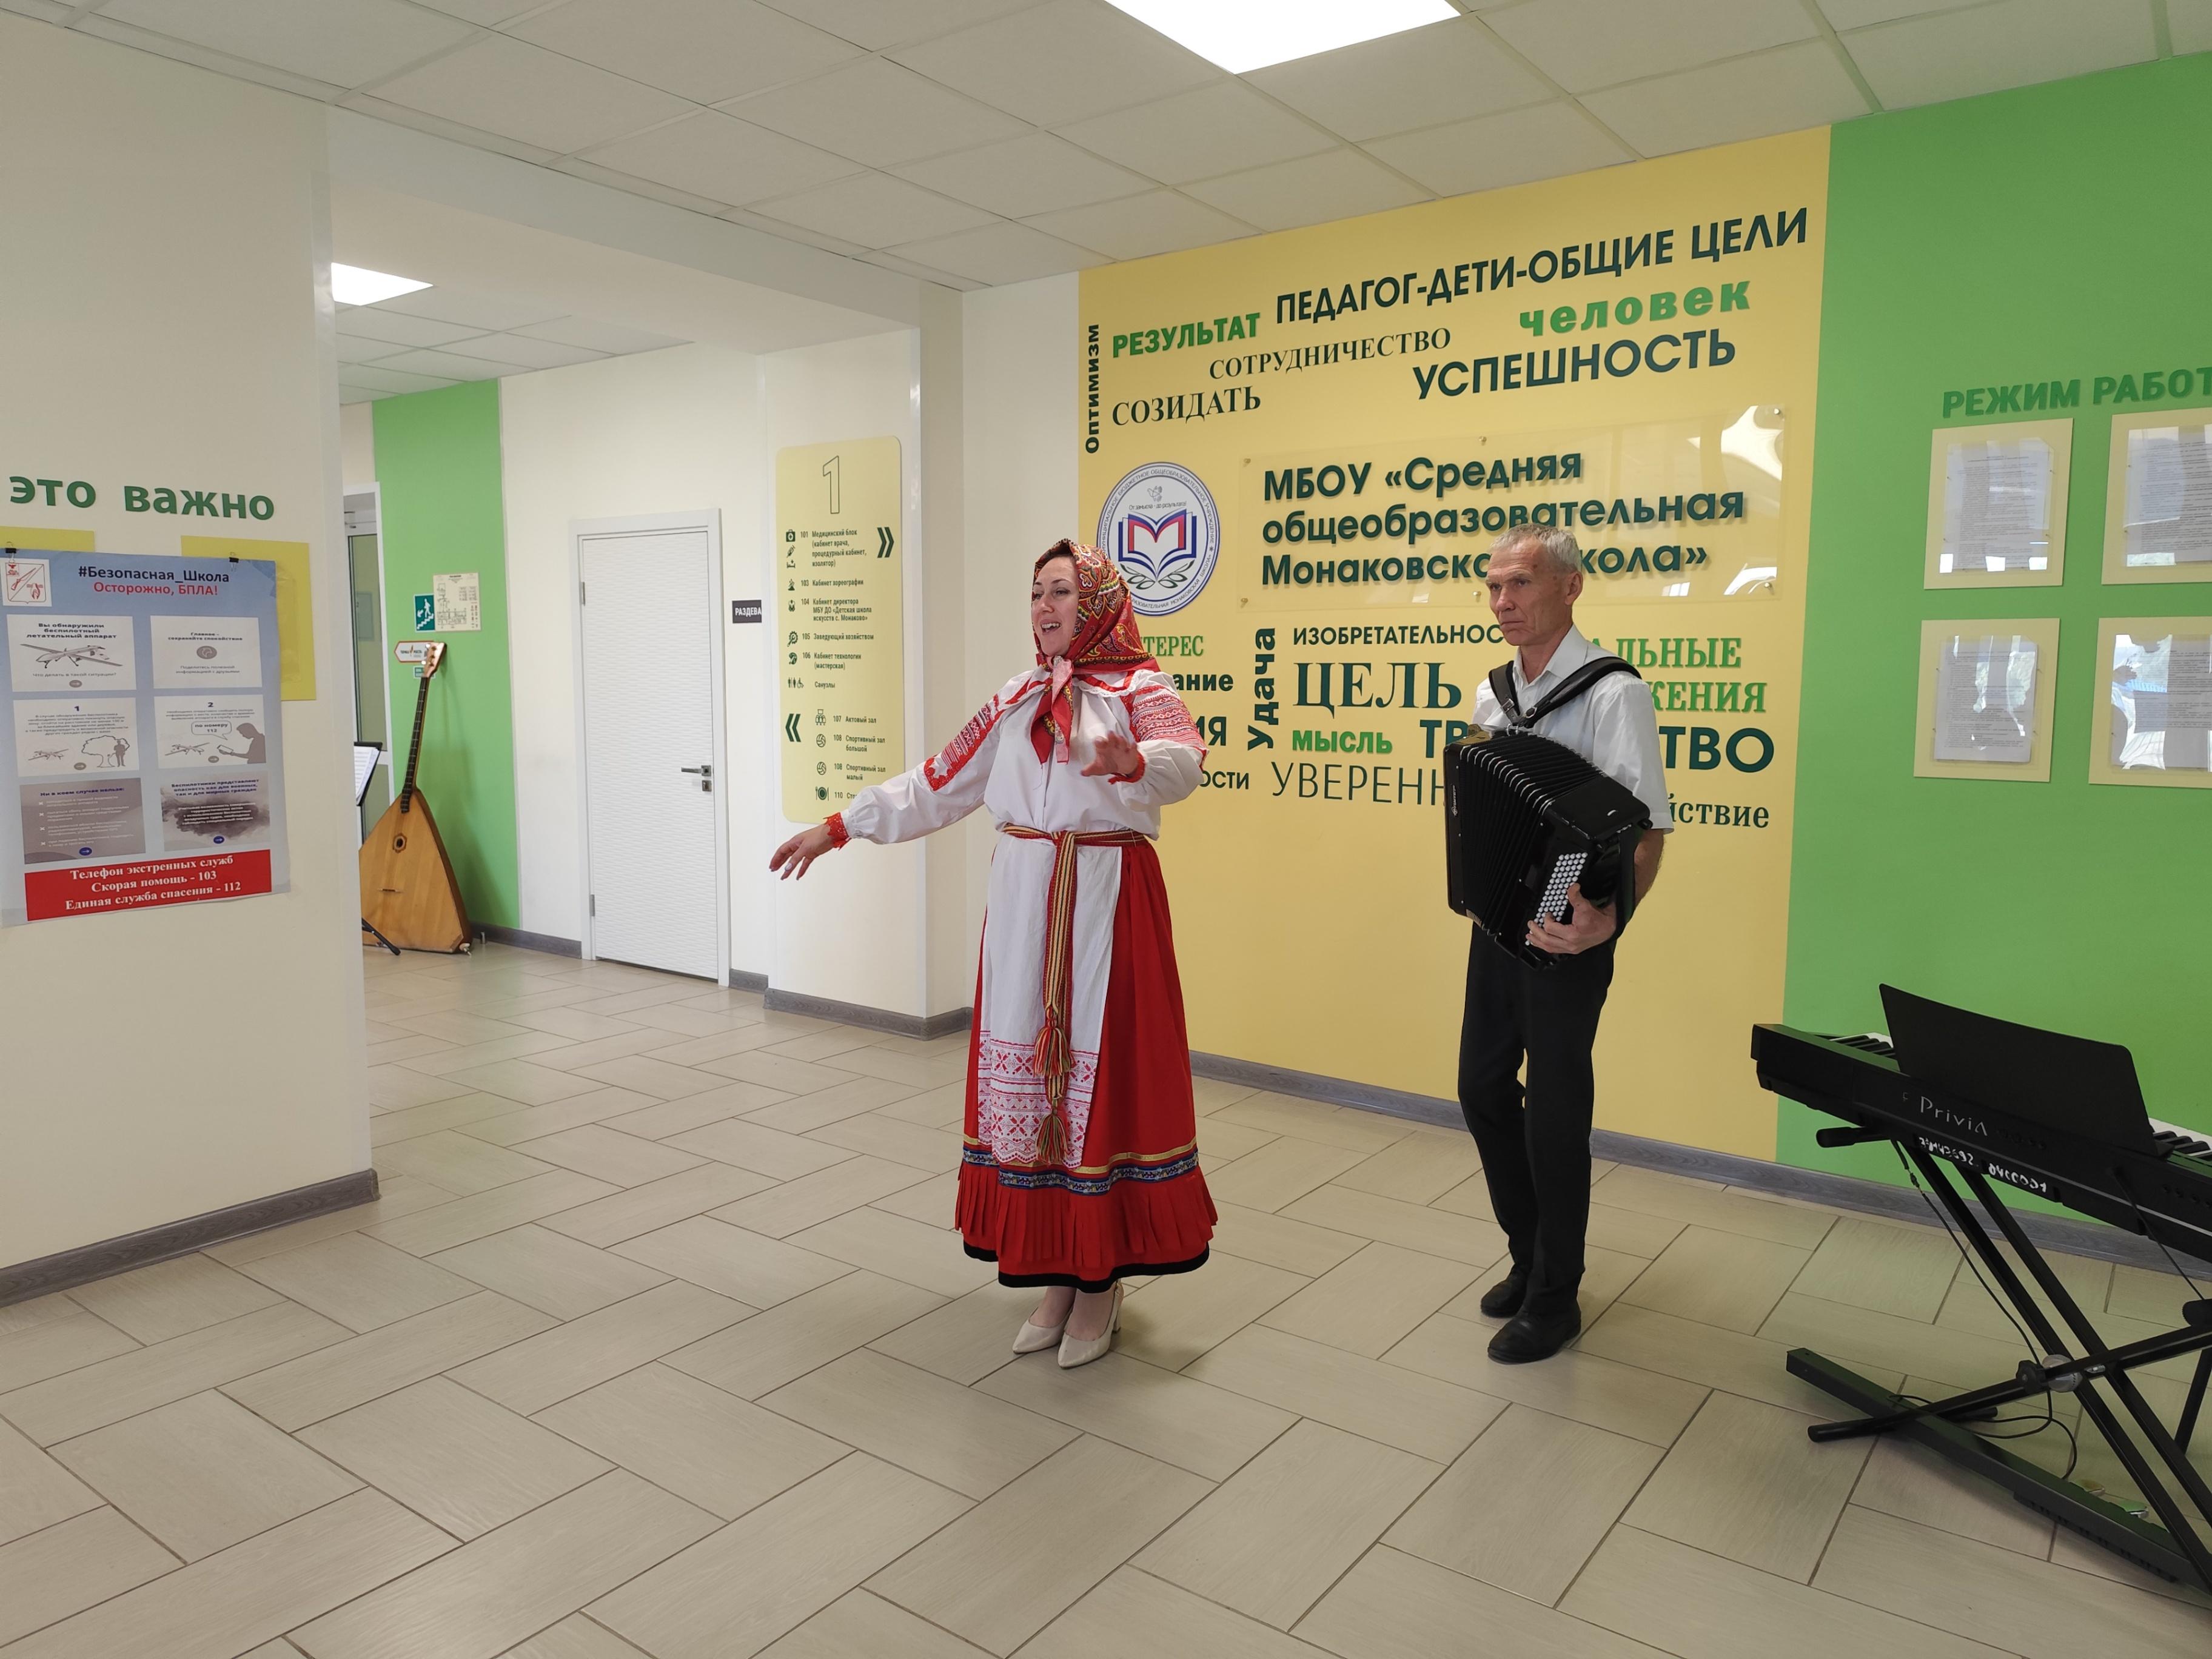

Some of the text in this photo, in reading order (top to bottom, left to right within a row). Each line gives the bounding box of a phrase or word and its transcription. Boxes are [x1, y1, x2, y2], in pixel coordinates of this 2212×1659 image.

[1276, 207, 1808, 324] ПЕДАГОГ-ДЕТИ-ОБЩИЕ ЦЕЛИ
[1519, 280, 1751, 337] человек
[1112, 312, 1261, 358] РЕЗУЛЬТАТ
[1209, 327, 1452, 380] СОТРУДНИЧЕСТВО
[1412, 328, 1736, 400] УСПЕШНОСТЬ
[1112, 386, 1261, 426] СОЗИДАТЬ
[1943, 379, 2080, 418] РЕЖИМ
[823, 455, 839, 514] 1
[1264, 452, 1582, 501] МБОУ «Средняя
[10, 476, 275, 520] это важно
[1262, 491, 1744, 545] общеобразовательная
[78, 566, 229, 583] #Безопасная_Школа
[93, 582, 218, 596] Осторожно, БПЛА!
[833, 578, 863, 587] хореографии
[735, 607, 762, 617] РАЗДЕВА
[814, 632, 845, 642] Заведующий
[1141, 635, 1204, 657] ТЕРЕС
[814, 662, 845, 671] (мастерская)
[1293, 662, 1463, 719] ЦЕЛЬ
[846, 735, 876, 743] Спортивный
[846, 763, 876, 773] Спортивный
[70, 855, 233, 880] Телефон экстренных служб
[91, 880, 137, 893] Скорая
[141, 874, 187, 887] помощь
[198, 871, 216, 881] 103
[65, 897, 112, 910] Единая
[115, 891, 157, 905] служба
[160, 886, 213, 899] спасения
[224, 881, 241, 892] 112
